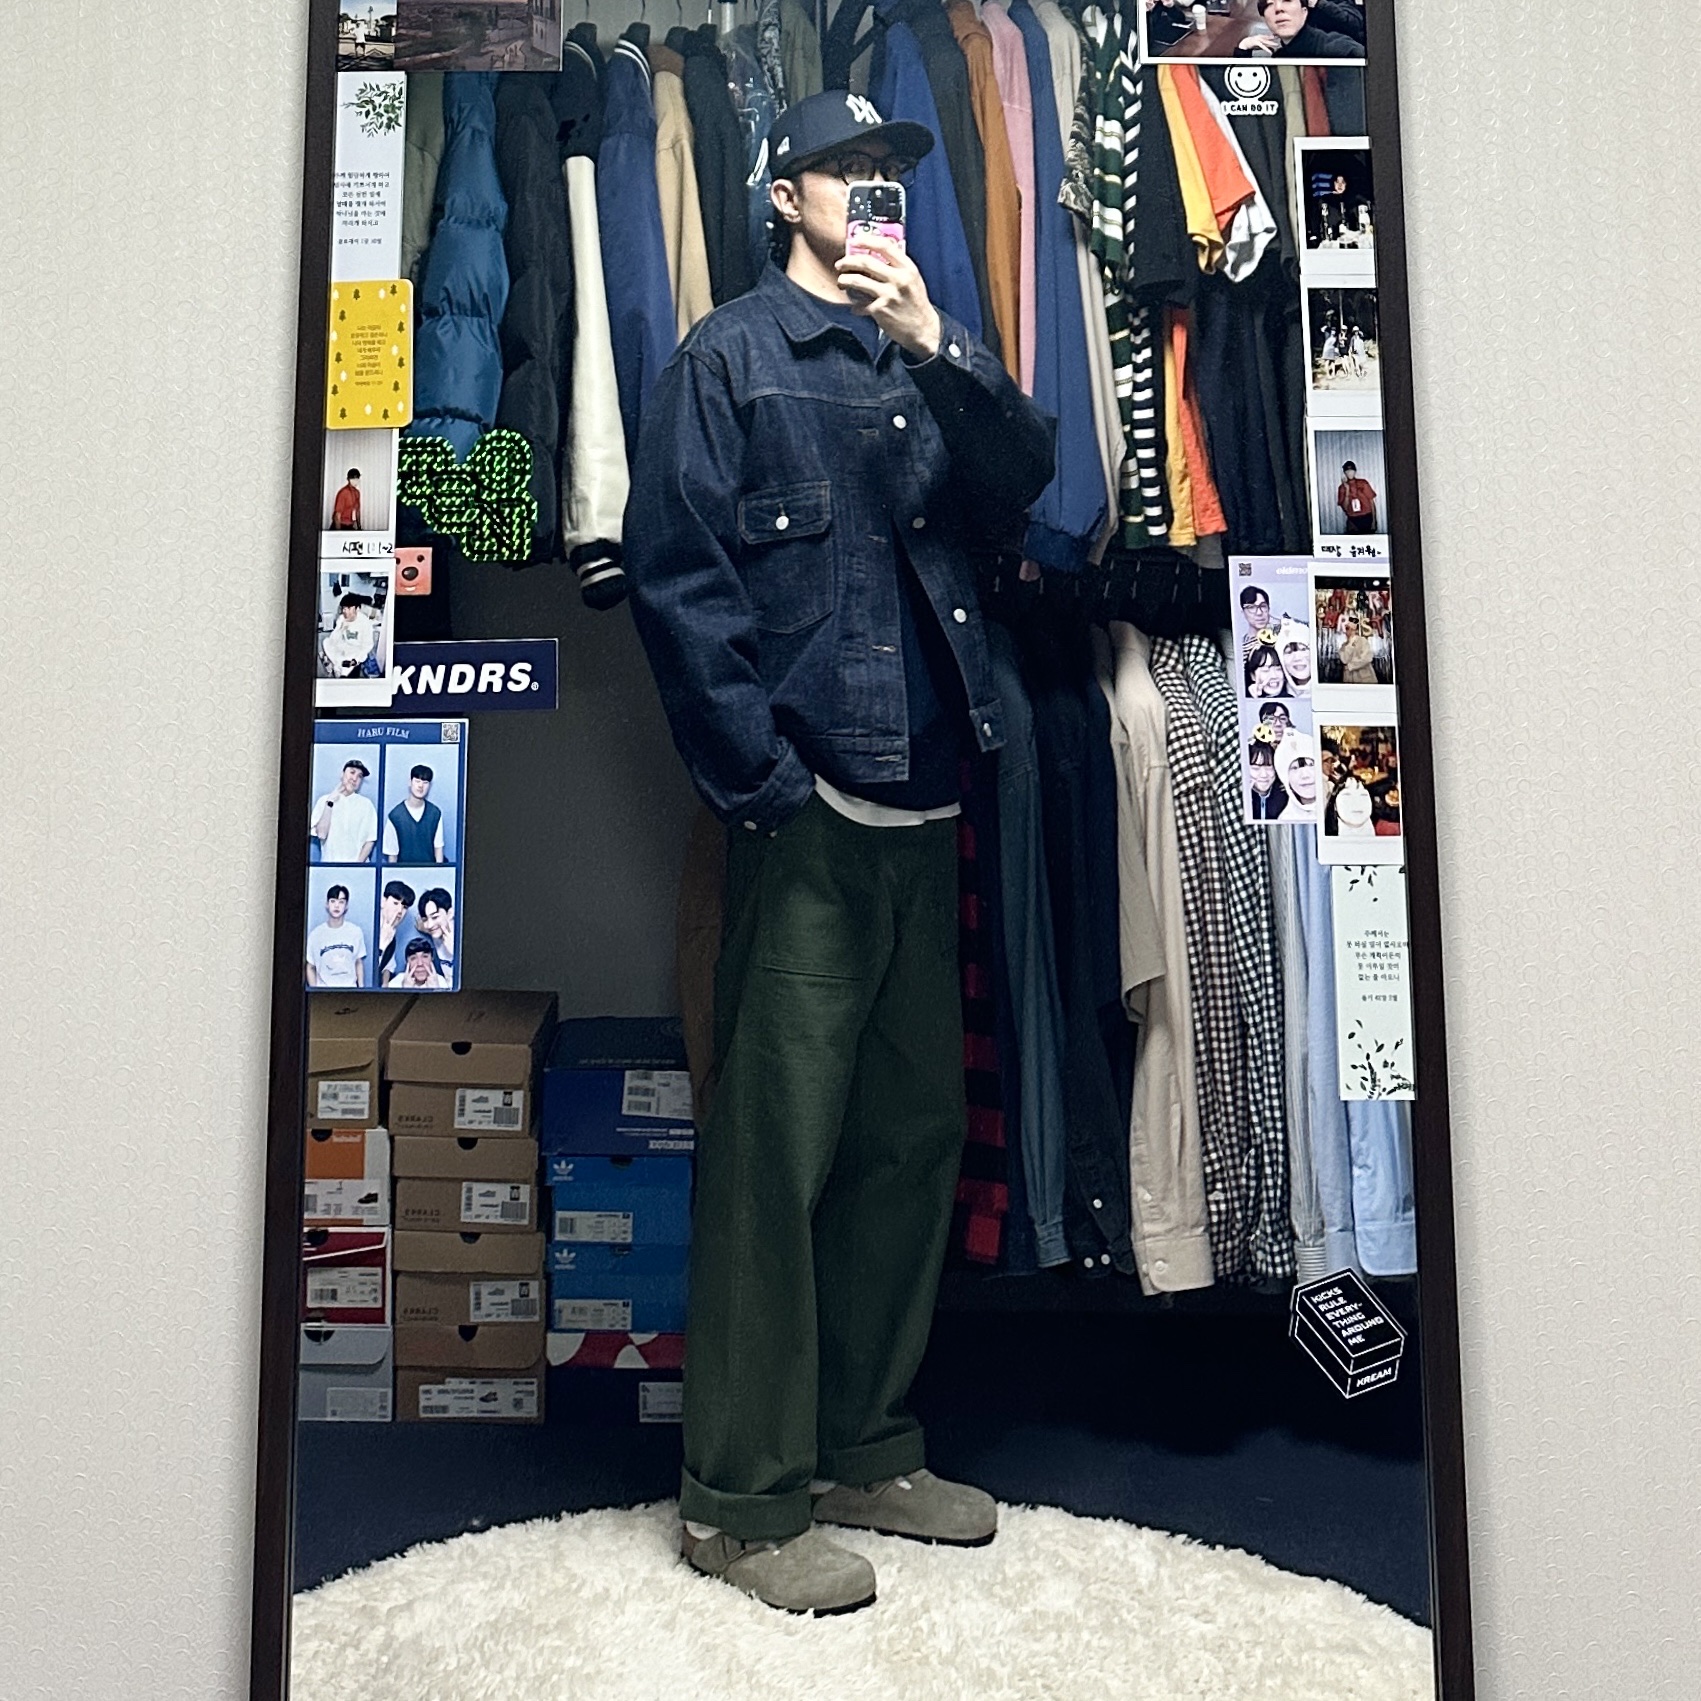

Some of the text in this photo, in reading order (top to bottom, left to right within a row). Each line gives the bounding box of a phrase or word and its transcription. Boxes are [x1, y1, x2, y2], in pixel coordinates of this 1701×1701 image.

[1230, 104, 1248, 112] CAN
[1266, 104, 1276, 112] IT
[357, 727, 410, 739] HARU FILM
[1310, 1286, 1343, 1304] KICKS
[1318, 1296, 1347, 1312] RULE
[1332, 1311, 1366, 1328] THING
[1341, 1316, 1384, 1337] AROUND
[1347, 1334, 1365, 1346] ME
[1356, 1367, 1392, 1387] KREAM
